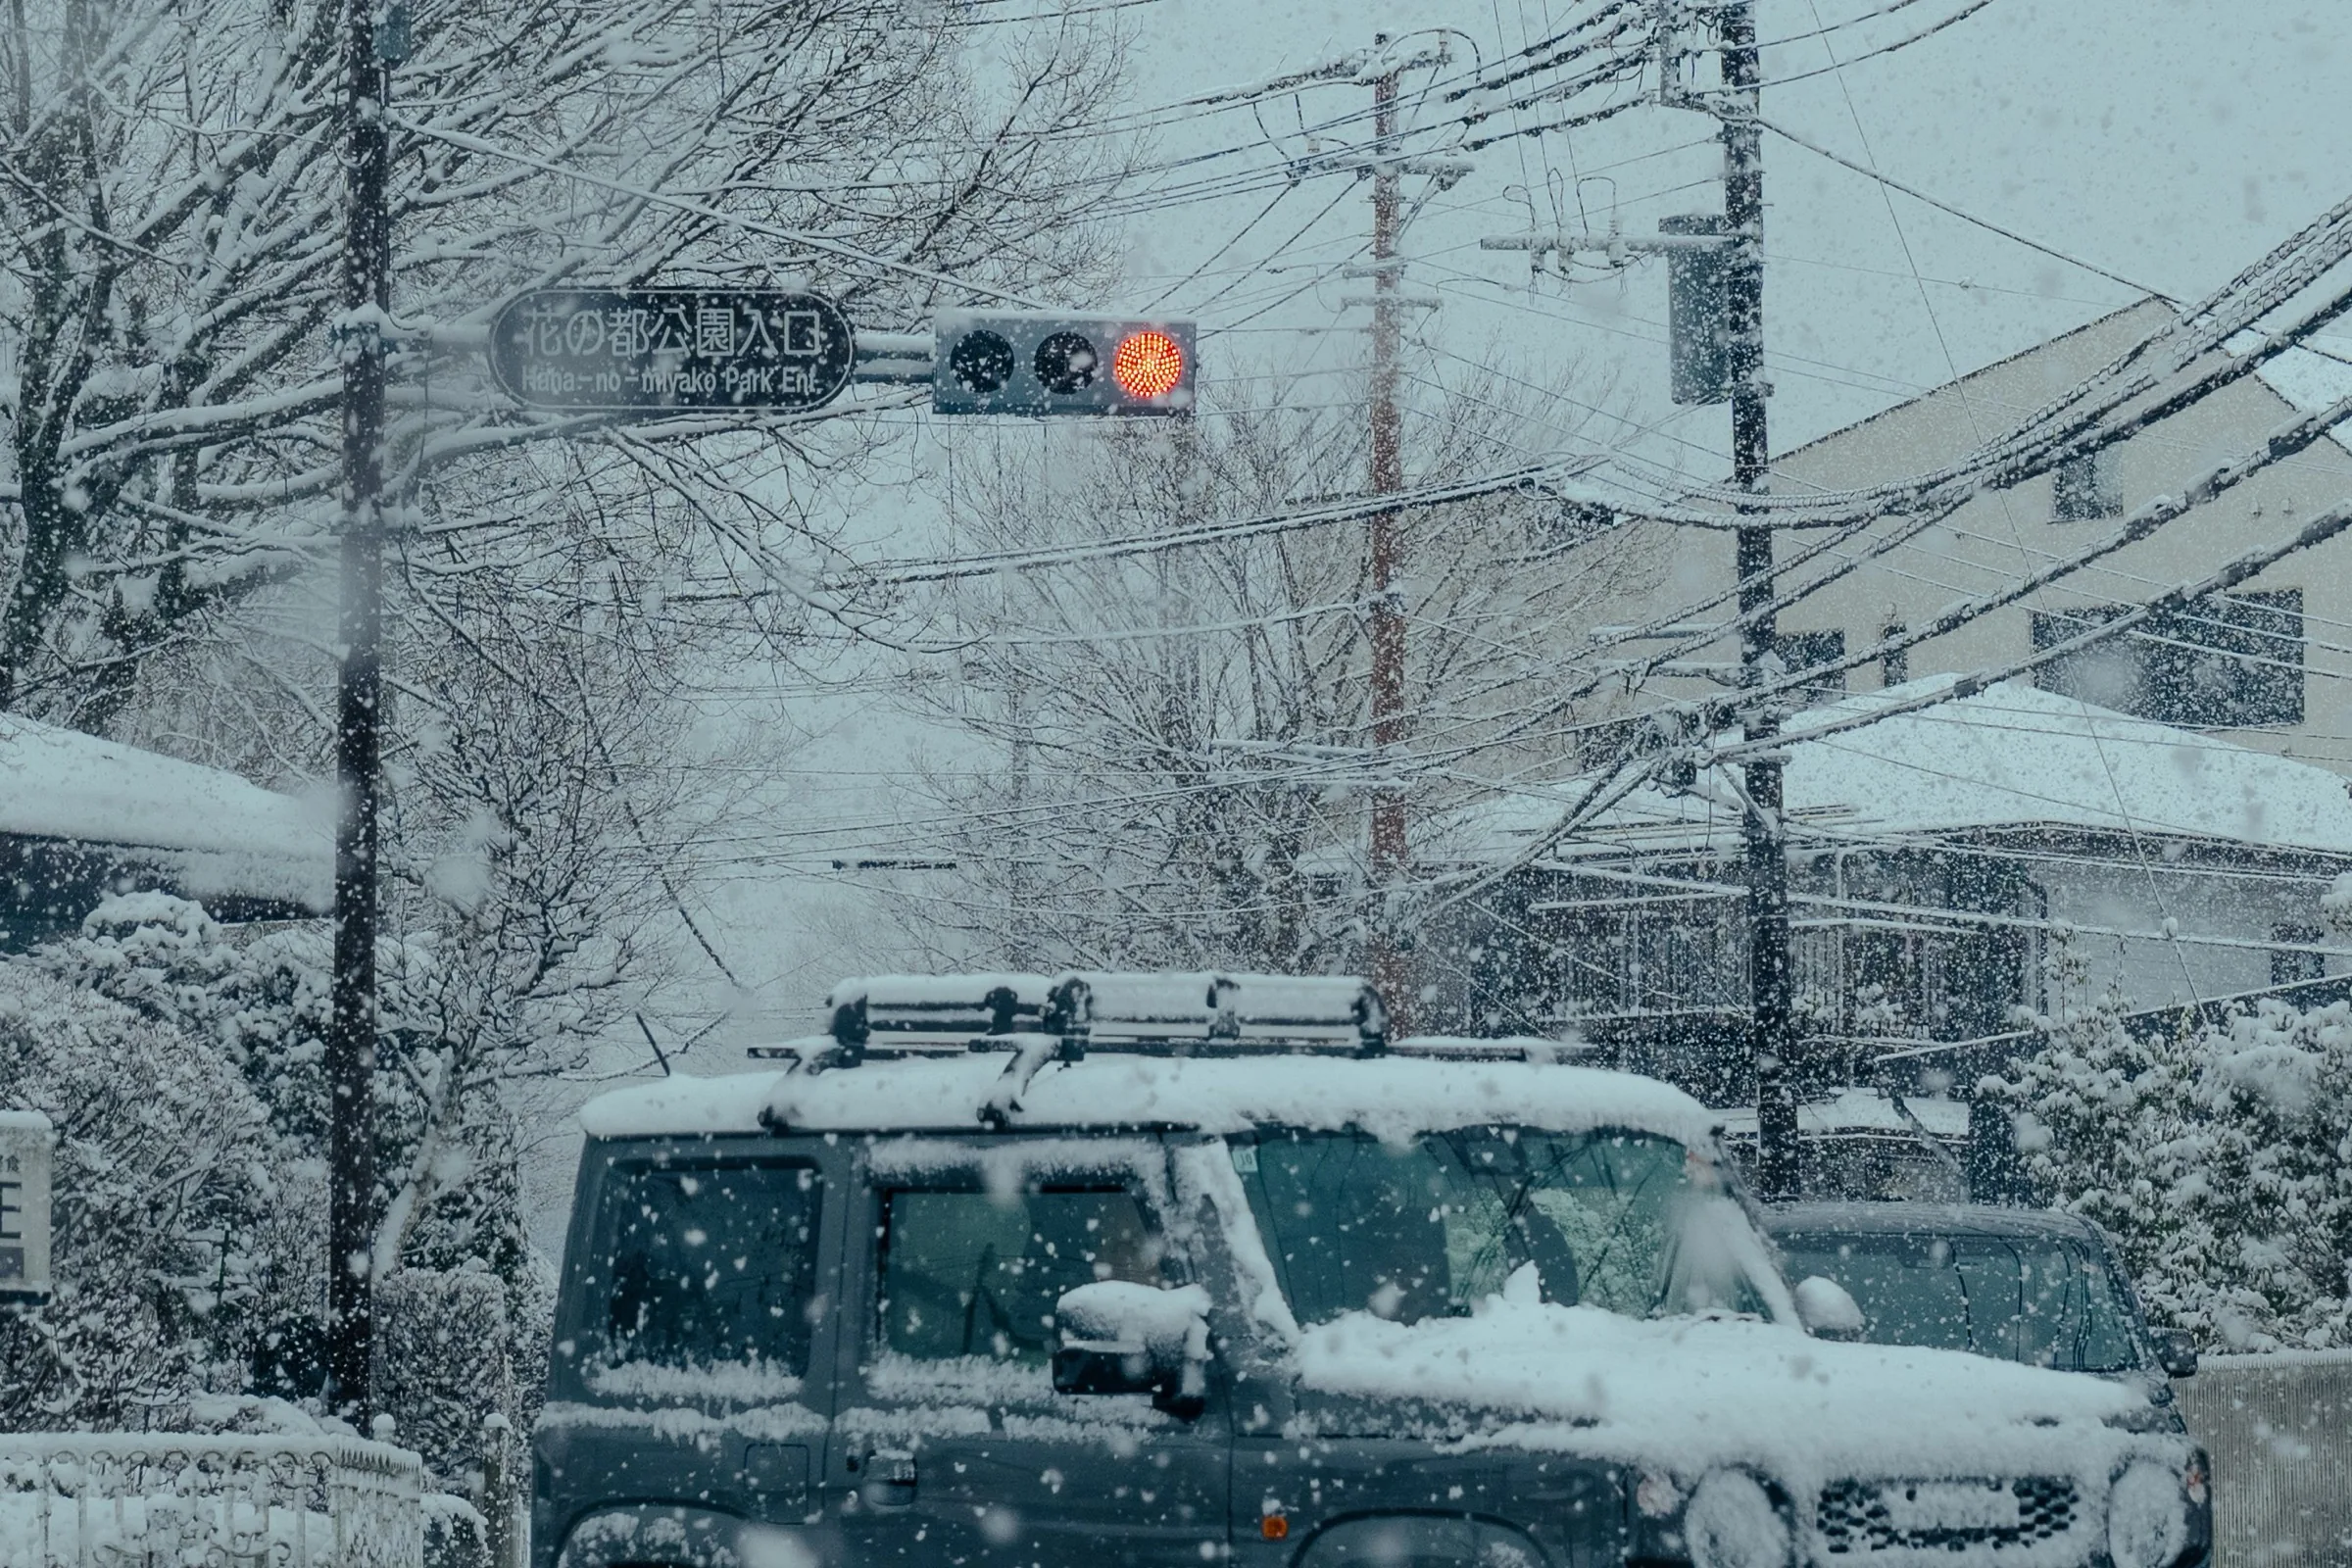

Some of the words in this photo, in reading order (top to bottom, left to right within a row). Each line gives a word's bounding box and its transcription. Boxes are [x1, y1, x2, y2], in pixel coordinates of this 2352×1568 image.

[526, 307, 821, 357] 花の都公園入口
[725, 366, 772, 393] Park
